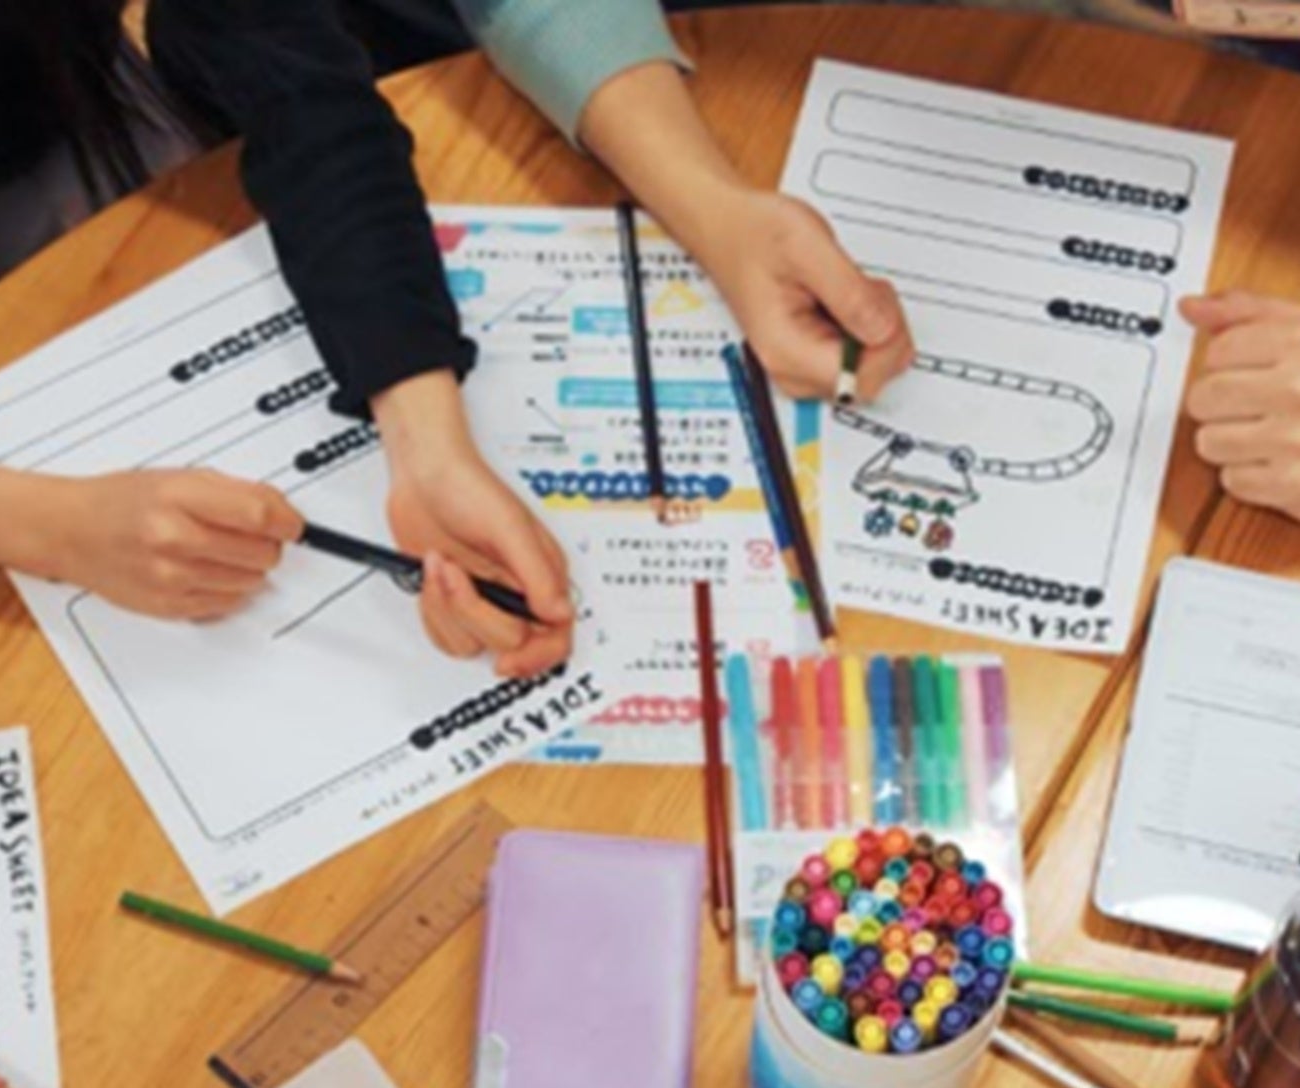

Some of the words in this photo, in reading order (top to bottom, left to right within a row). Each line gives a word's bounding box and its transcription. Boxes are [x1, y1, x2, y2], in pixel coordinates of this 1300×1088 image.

[939, 600, 1021, 633] SHEET
[1029, 614, 1113, 643] IDEA
[524, 672, 603, 732] IDEA
[448, 716, 528, 774] SHEET
